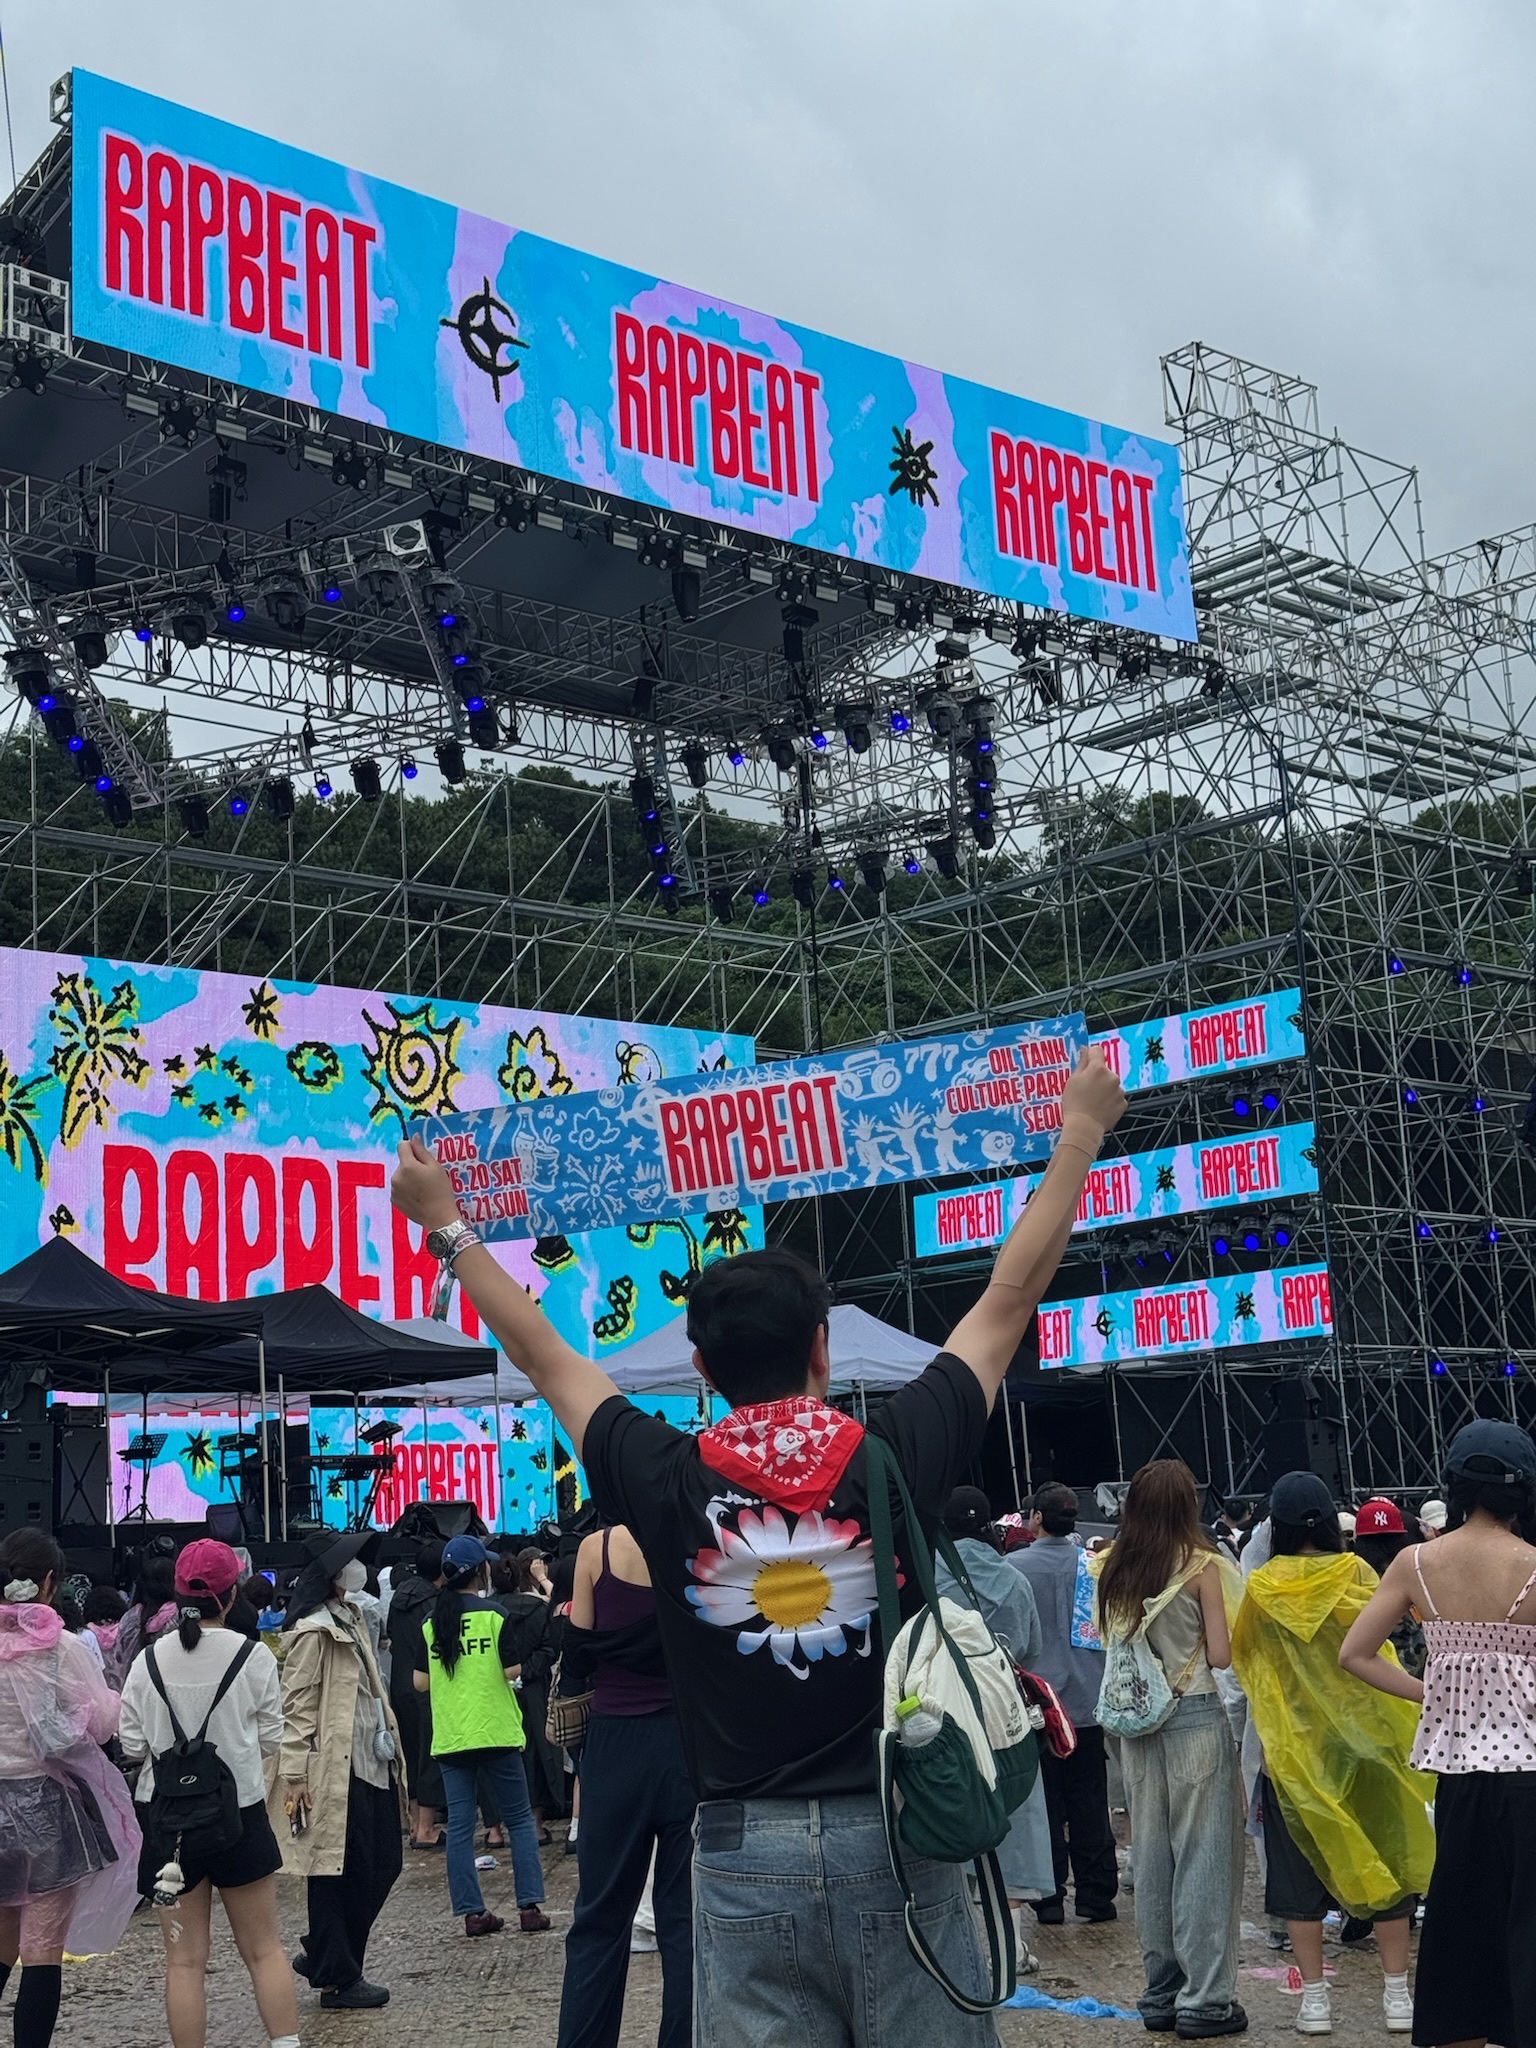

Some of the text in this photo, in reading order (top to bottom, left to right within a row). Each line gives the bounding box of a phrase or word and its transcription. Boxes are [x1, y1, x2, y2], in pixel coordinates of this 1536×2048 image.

[104, 134, 1156, 592] RAPBEAT RAPBEAT RAPBEAT
[989, 1048, 1019, 1075] OIL
[1019, 1037, 1069, 1069] TANK
[1188, 1004, 1266, 1068] RAPBEAT
[946, 1068, 1071, 1115] CULTURE PARK
[660, 1076, 843, 1193] RAPBEAT
[1023, 1102, 1064, 1134] SEOU
[433, 1133, 477, 1164] 2026
[445, 1157, 522, 1194] 6.20 SAT
[937, 1137, 1280, 1246] RAPBEAT PBEAT RAPBEAT
[455, 1189, 529, 1223] 6.21 SUN
[103, 1144, 480, 1341] RAPBEA
[1133, 1289, 1209, 1348] RAPBEAT
[430, 1638, 491, 1660] SAFF
